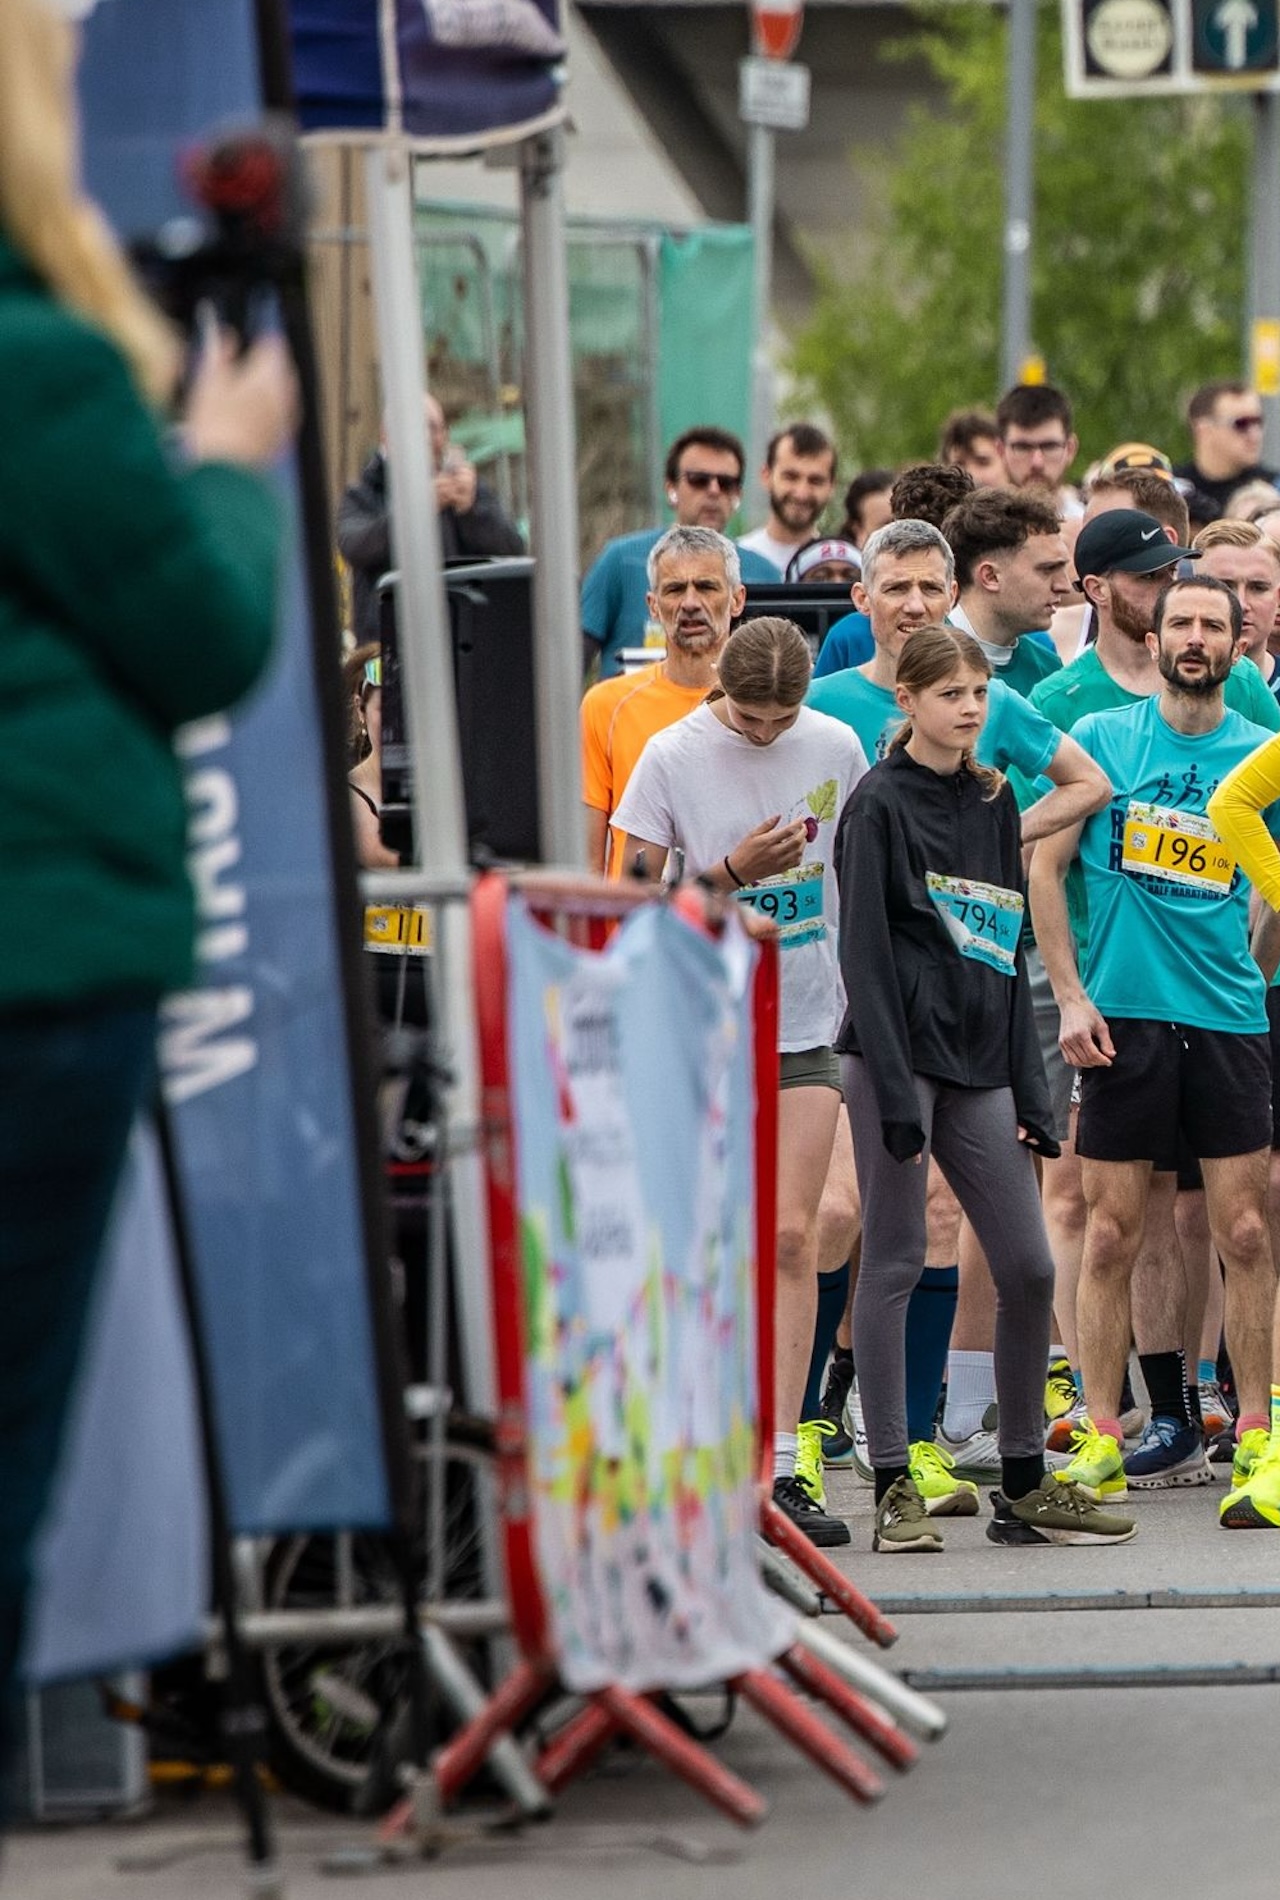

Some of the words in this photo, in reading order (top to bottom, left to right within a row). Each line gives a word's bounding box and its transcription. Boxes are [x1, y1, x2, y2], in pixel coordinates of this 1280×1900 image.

[1154, 833, 1207, 873] 196
[1212, 856, 1230, 871] 10k
[737, 889, 798, 921] 793
[954, 900, 998, 939] 794
